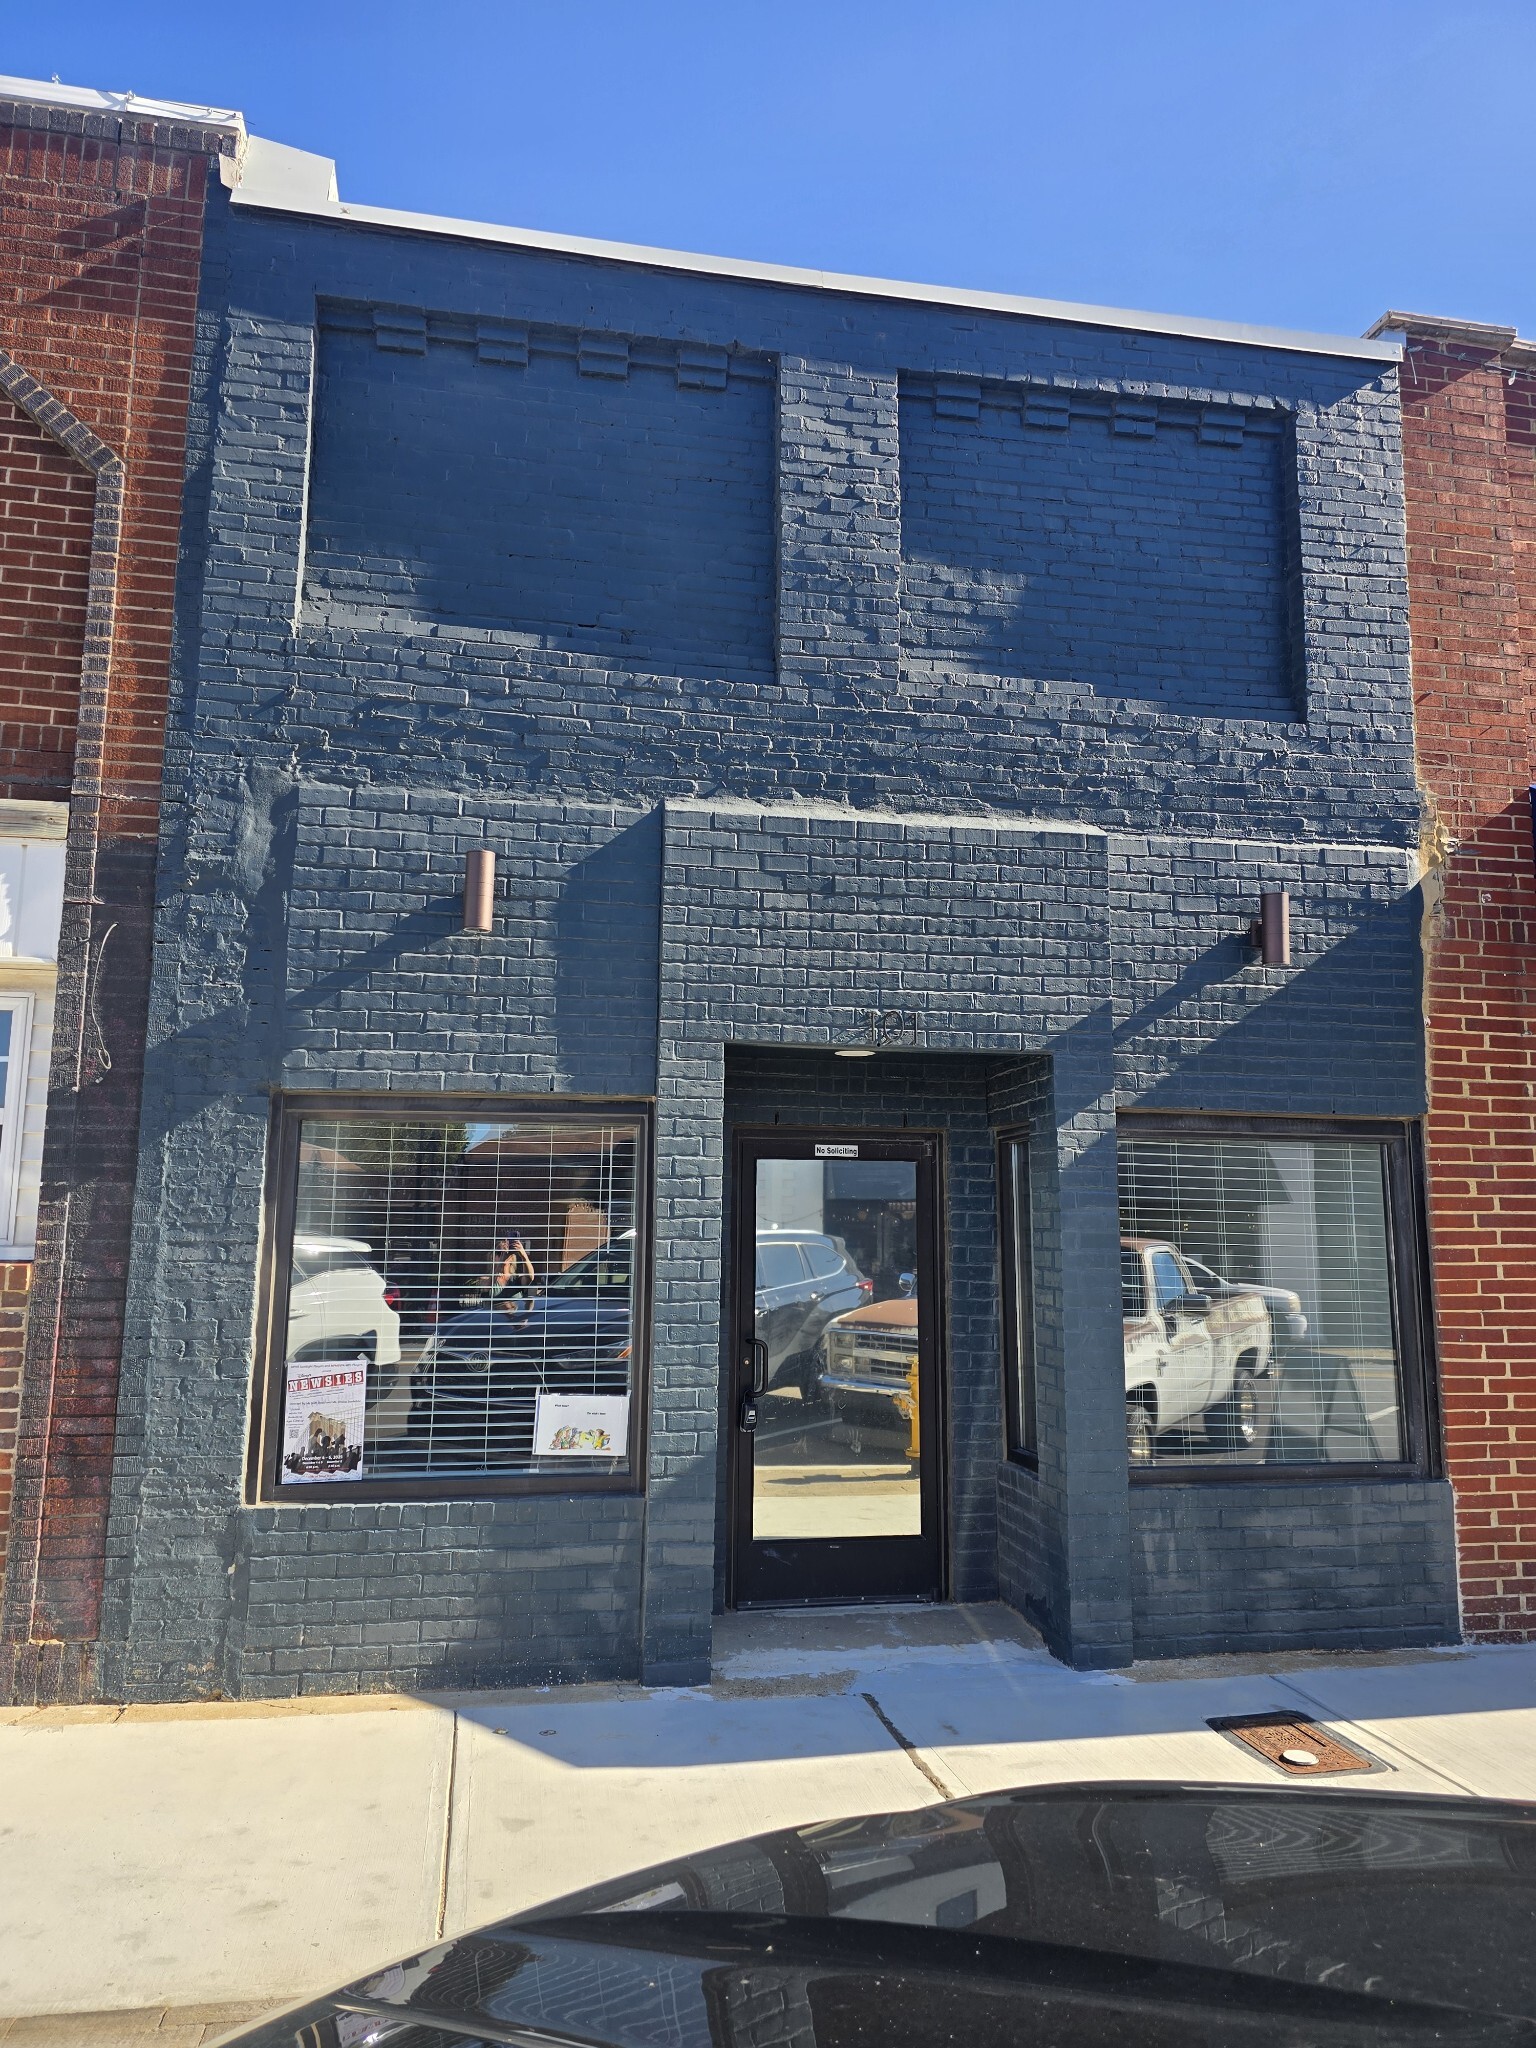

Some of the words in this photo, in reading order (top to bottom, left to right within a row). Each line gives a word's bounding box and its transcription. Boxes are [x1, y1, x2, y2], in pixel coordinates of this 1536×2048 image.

[816, 1146, 826, 1154] No
[826, 1146, 858, 1157] Soliciting
[288, 1370, 364, 1392] NEWSIES
